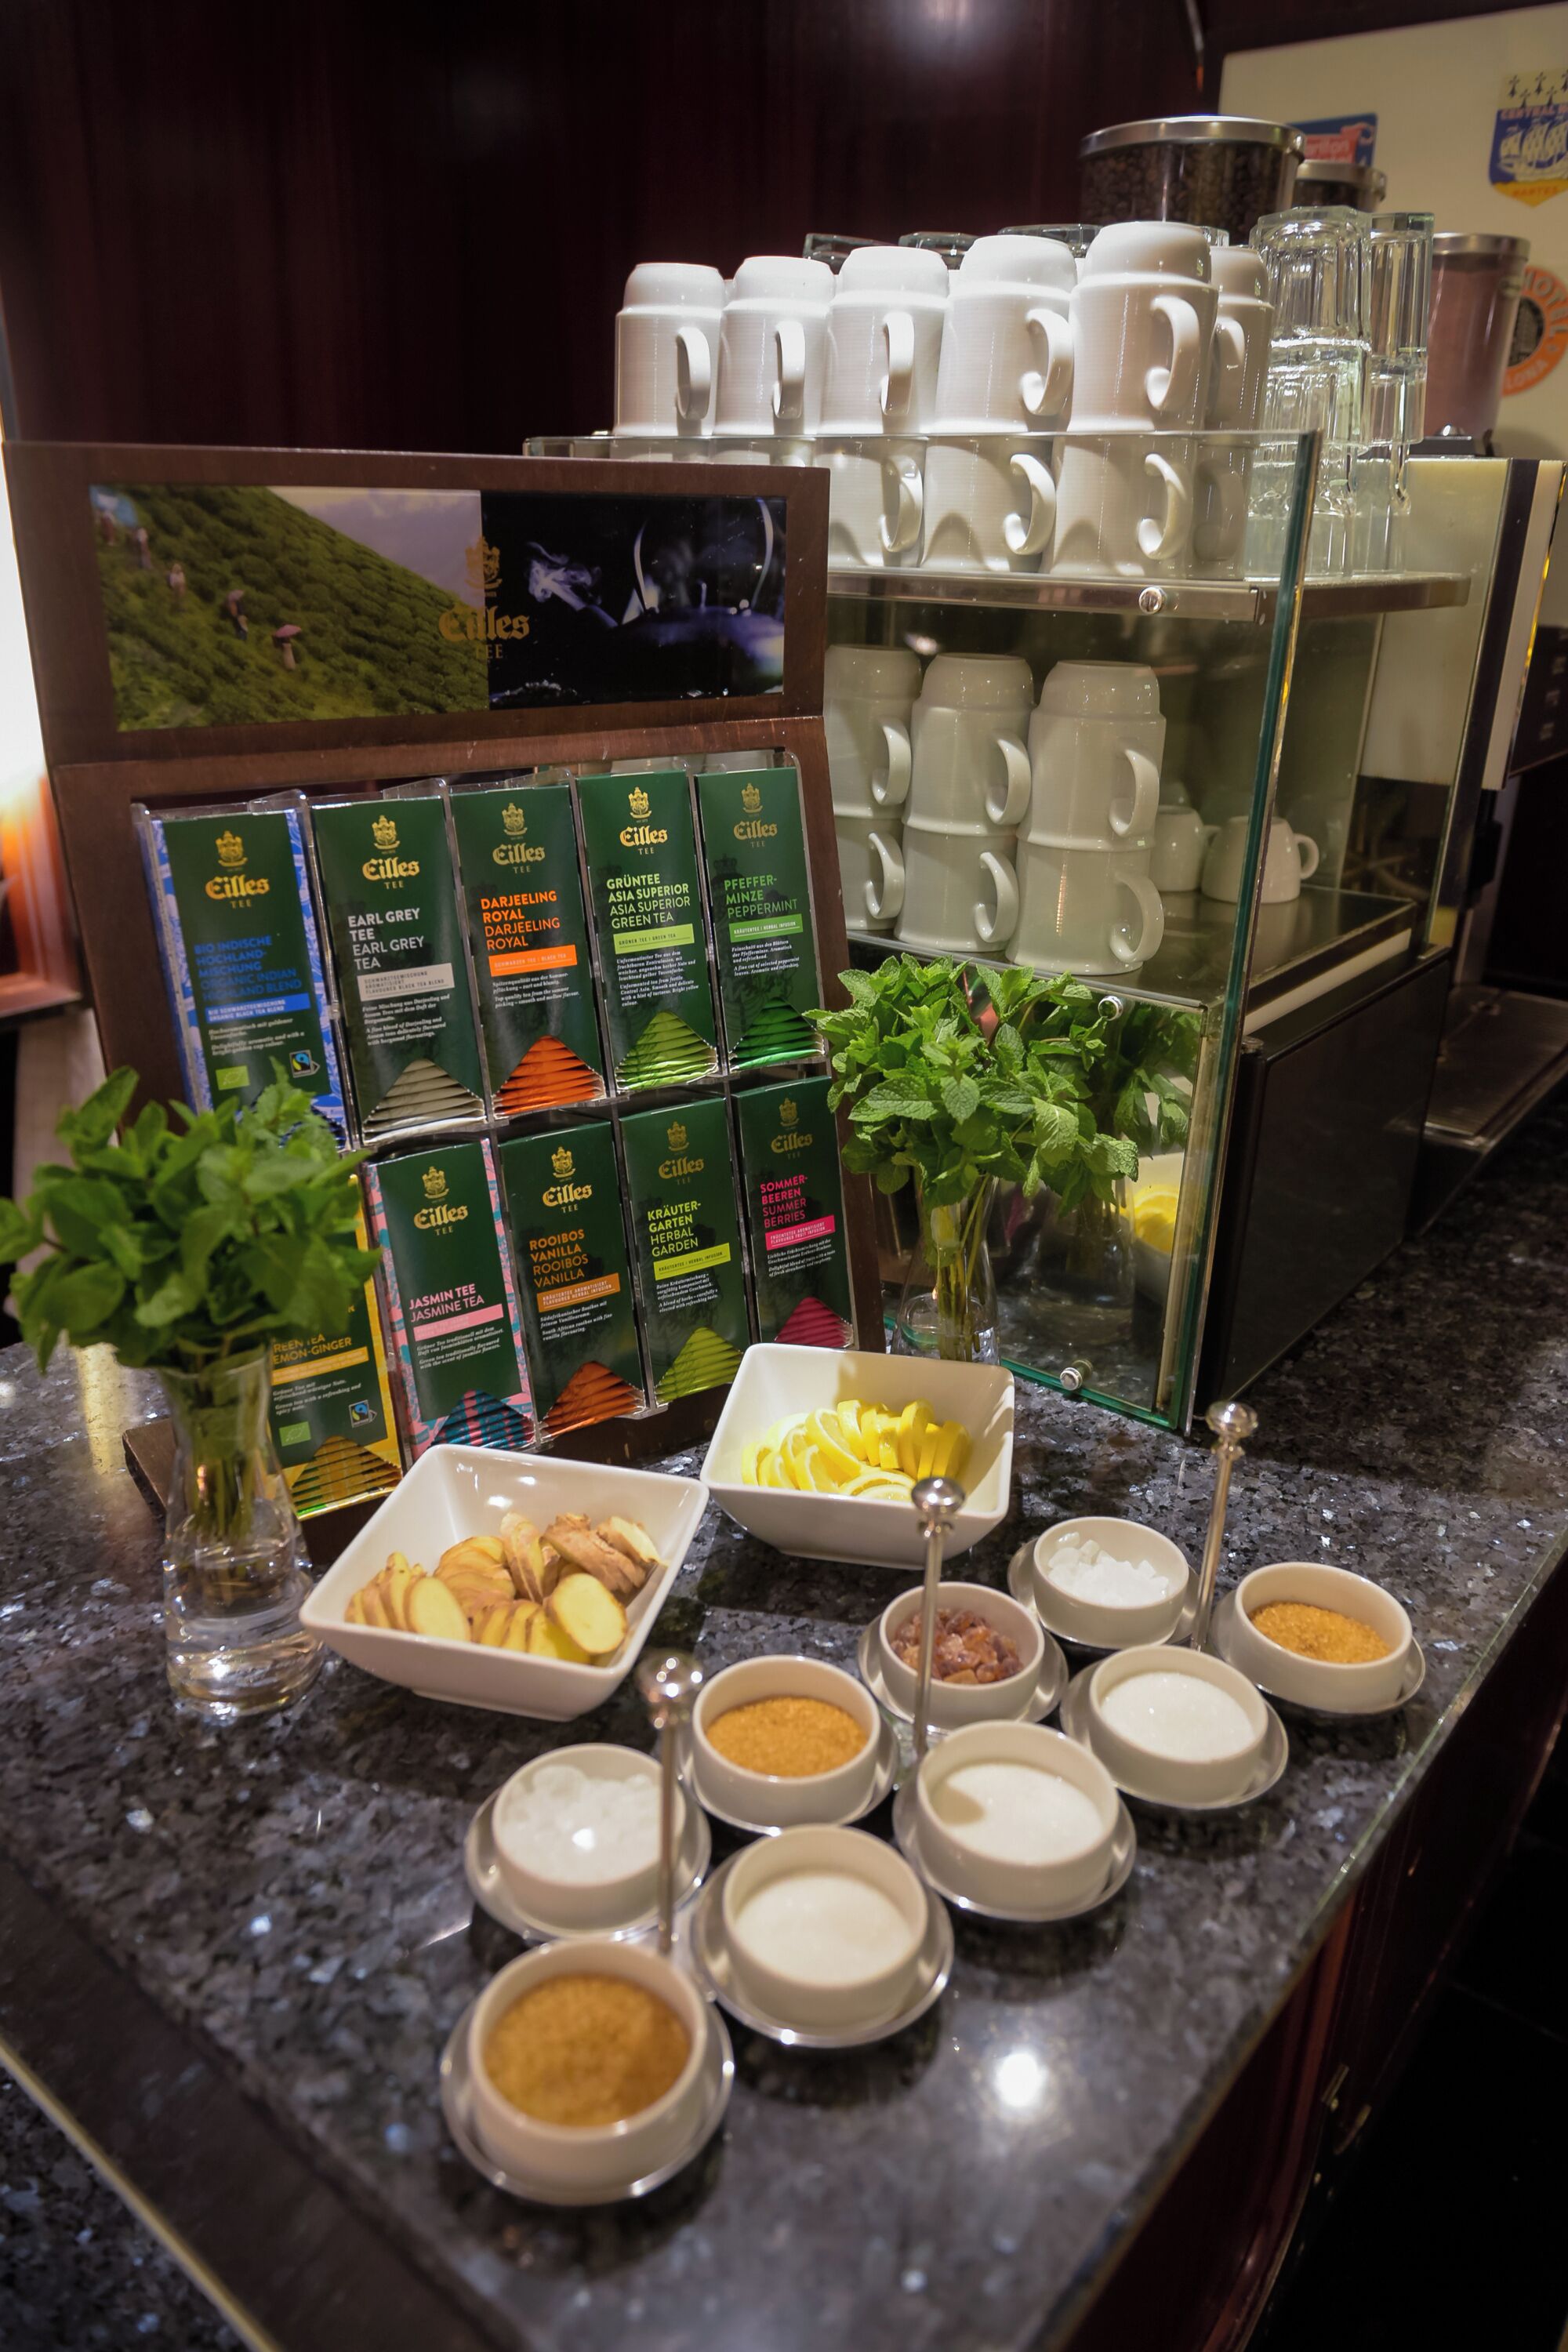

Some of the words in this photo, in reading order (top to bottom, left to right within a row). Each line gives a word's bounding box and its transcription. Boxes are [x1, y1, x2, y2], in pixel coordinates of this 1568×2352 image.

[439, 604, 530, 641] Eilles
[619, 826, 667, 847] Eilles
[734, 820, 778, 840] Eilles
[492, 843, 546, 865] Eilles
[362, 857, 420, 880] Eilles
[205, 874, 270, 900] Eilles
[607, 873, 660, 889] GRÜNTEE
[724, 875, 777, 891] PFEFFER-
[481, 891, 557, 909] DARJEELING
[608, 890, 634, 902] ASIA
[637, 883, 688, 897] SUPERIOR
[726, 889, 764, 904] MINZE
[230, 898, 252, 909] TEE
[610, 903, 636, 916] ASIA
[638, 897, 690, 911] SUPERIOR
[728, 898, 797, 918] PEPPERMINT
[348, 911, 383, 927] EARL
[386, 908, 420, 923] GREY
[483, 909, 524, 923] ROYAL
[612, 916, 651, 928] GREEN
[653, 913, 673, 923] TEA
[350, 924, 375, 941] TEE
[485, 917, 560, 937] DARJEELING
[194, 942, 214, 954] BIO
[218, 935, 272, 953] INDISCHE
[353, 941, 387, 956] EARL
[390, 936, 424, 951] GREY
[487, 935, 528, 950] ROYAL
[196, 949, 267, 966] HOCHLAND-
[354, 958, 381, 971] TEA
[198, 961, 262, 978] MISCHUNG
[201, 975, 253, 989] ORGANIC
[256, 969, 296, 985] INDIAN
[203, 985, 260, 1000] HIGHLAND
[263, 979, 301, 996] BLEND
[771, 1132, 813, 1153] Eilles
[658, 1156, 704, 1179] Eilles
[760, 1174, 808, 1193] SOMMER-
[542, 1183, 592, 1207] Eilles
[761, 1188, 801, 1204] BEEREN
[413, 1204, 468, 1229] Eilles
[561, 1204, 578, 1213] TEE
[648, 1200, 702, 1221] KRÄUTER-
[763, 1198, 807, 1216] SUMMER
[649, 1214, 692, 1232] GARTEN
[764, 1211, 806, 1229] BERRIES
[434, 1225, 453, 1236] TEE
[529, 1229, 585, 1250] ROOIBOS
[650, 1227, 694, 1246] HERBAL
[531, 1243, 582, 1263] VANILLA
[652, 1237, 698, 1258] GARDEN
[533, 1254, 588, 1276] ROOIBOS
[534, 1268, 585, 1288] VANILLA
[409, 1289, 452, 1309] JASMIN
[456, 1283, 475, 1296] TEE
[410, 1300, 461, 1322] JASMINE
[463, 1295, 485, 1308] TEA
[272, 1338, 303, 1353] REEN
[273, 1337, 352, 1365] EMON-GINGER
